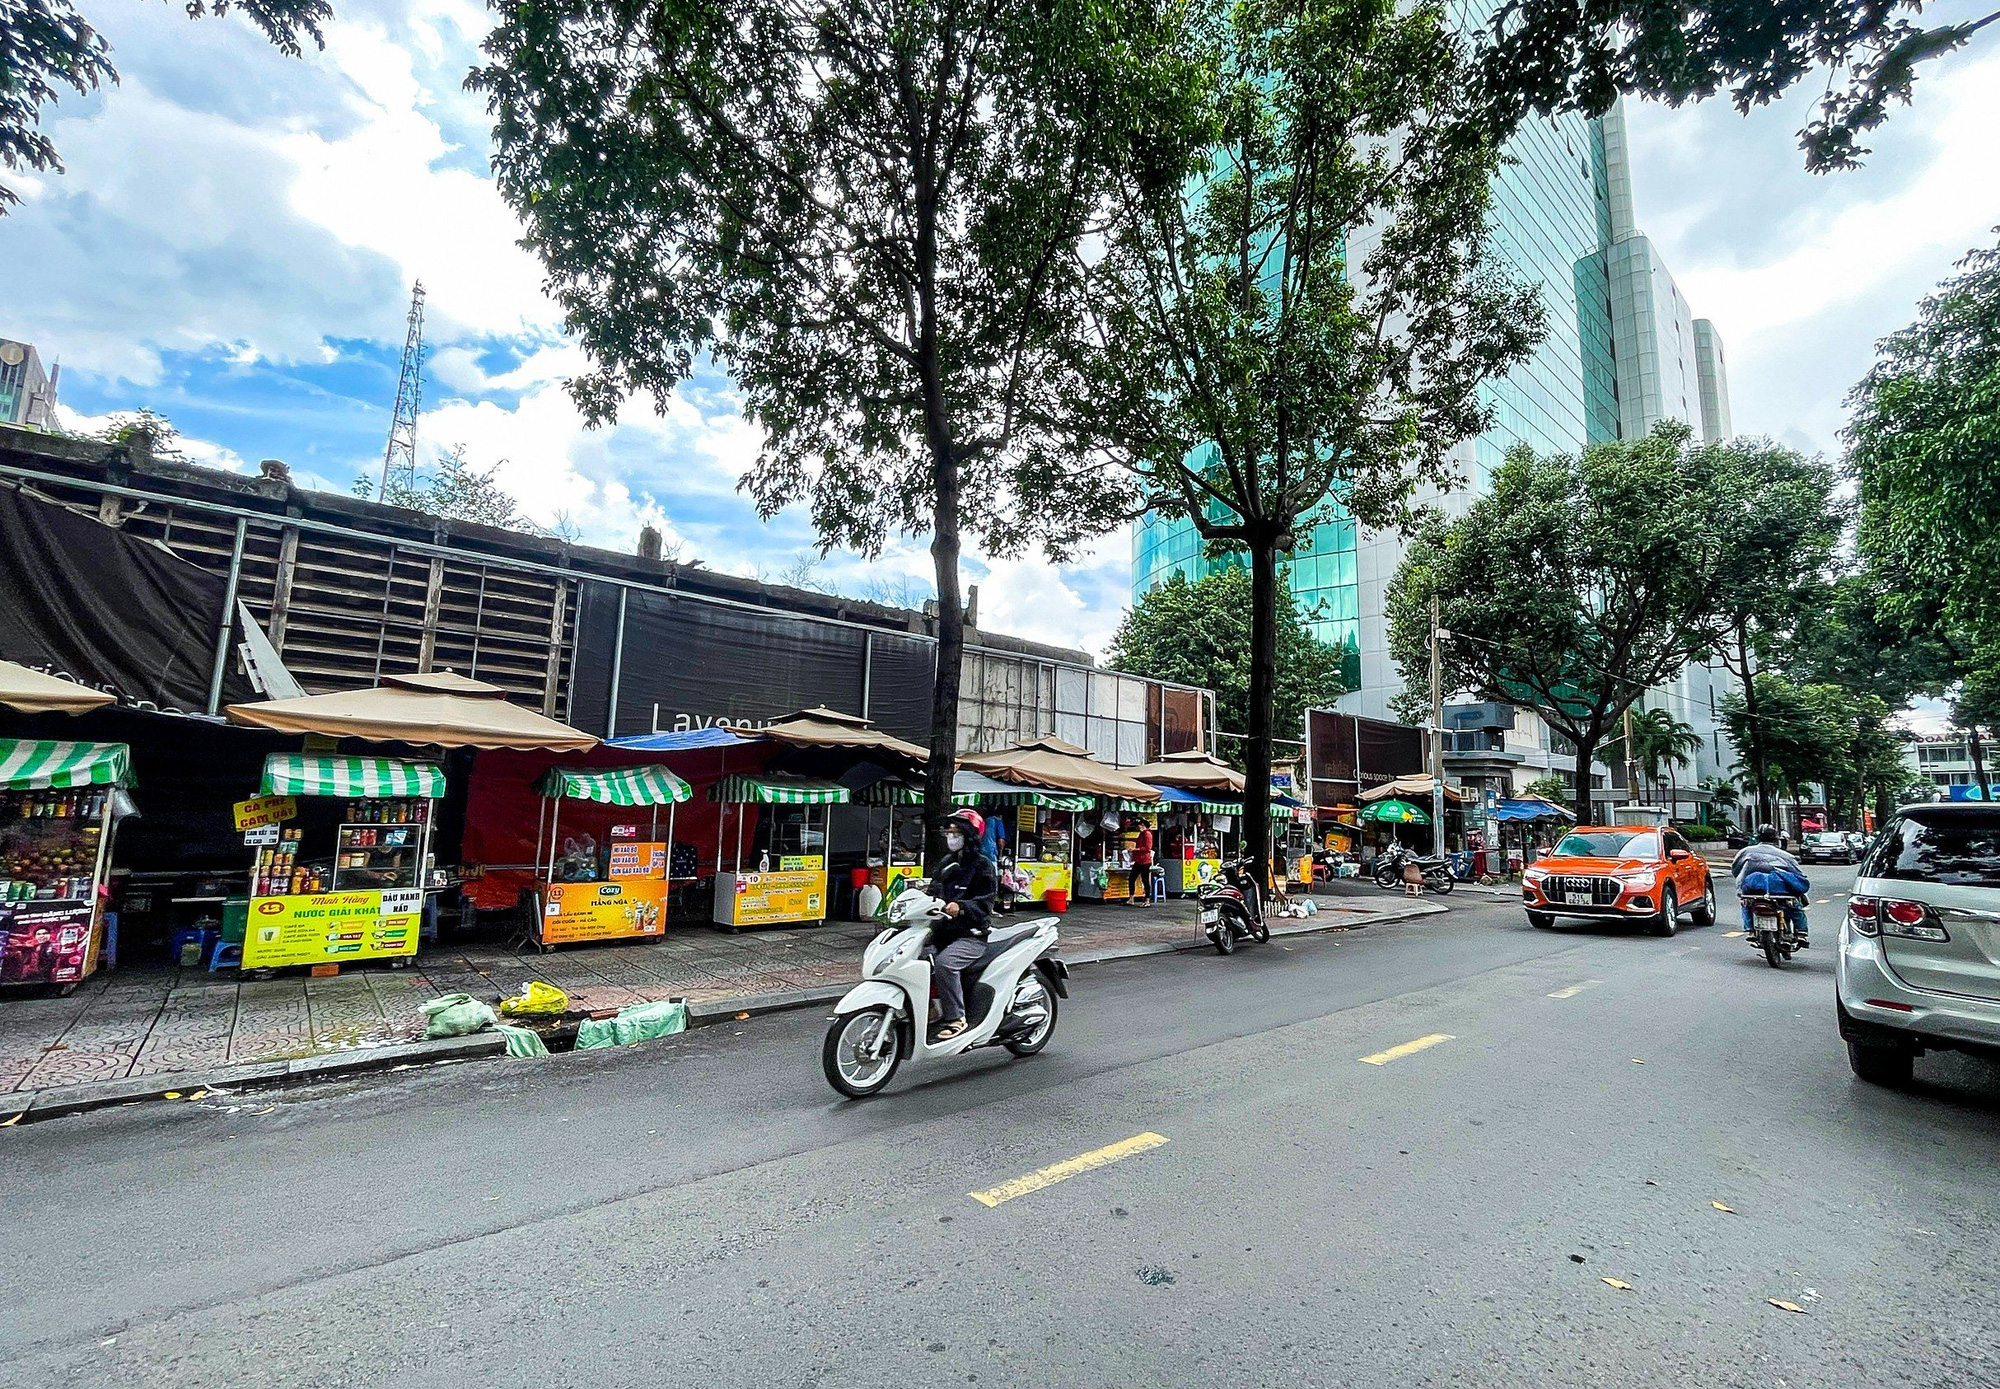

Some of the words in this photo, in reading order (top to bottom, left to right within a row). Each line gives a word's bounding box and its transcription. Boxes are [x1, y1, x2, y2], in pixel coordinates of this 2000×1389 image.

[601, 886, 620, 894] Cozy
[311, 896, 338, 905] Minh
[262, 904, 281, 913] 12
